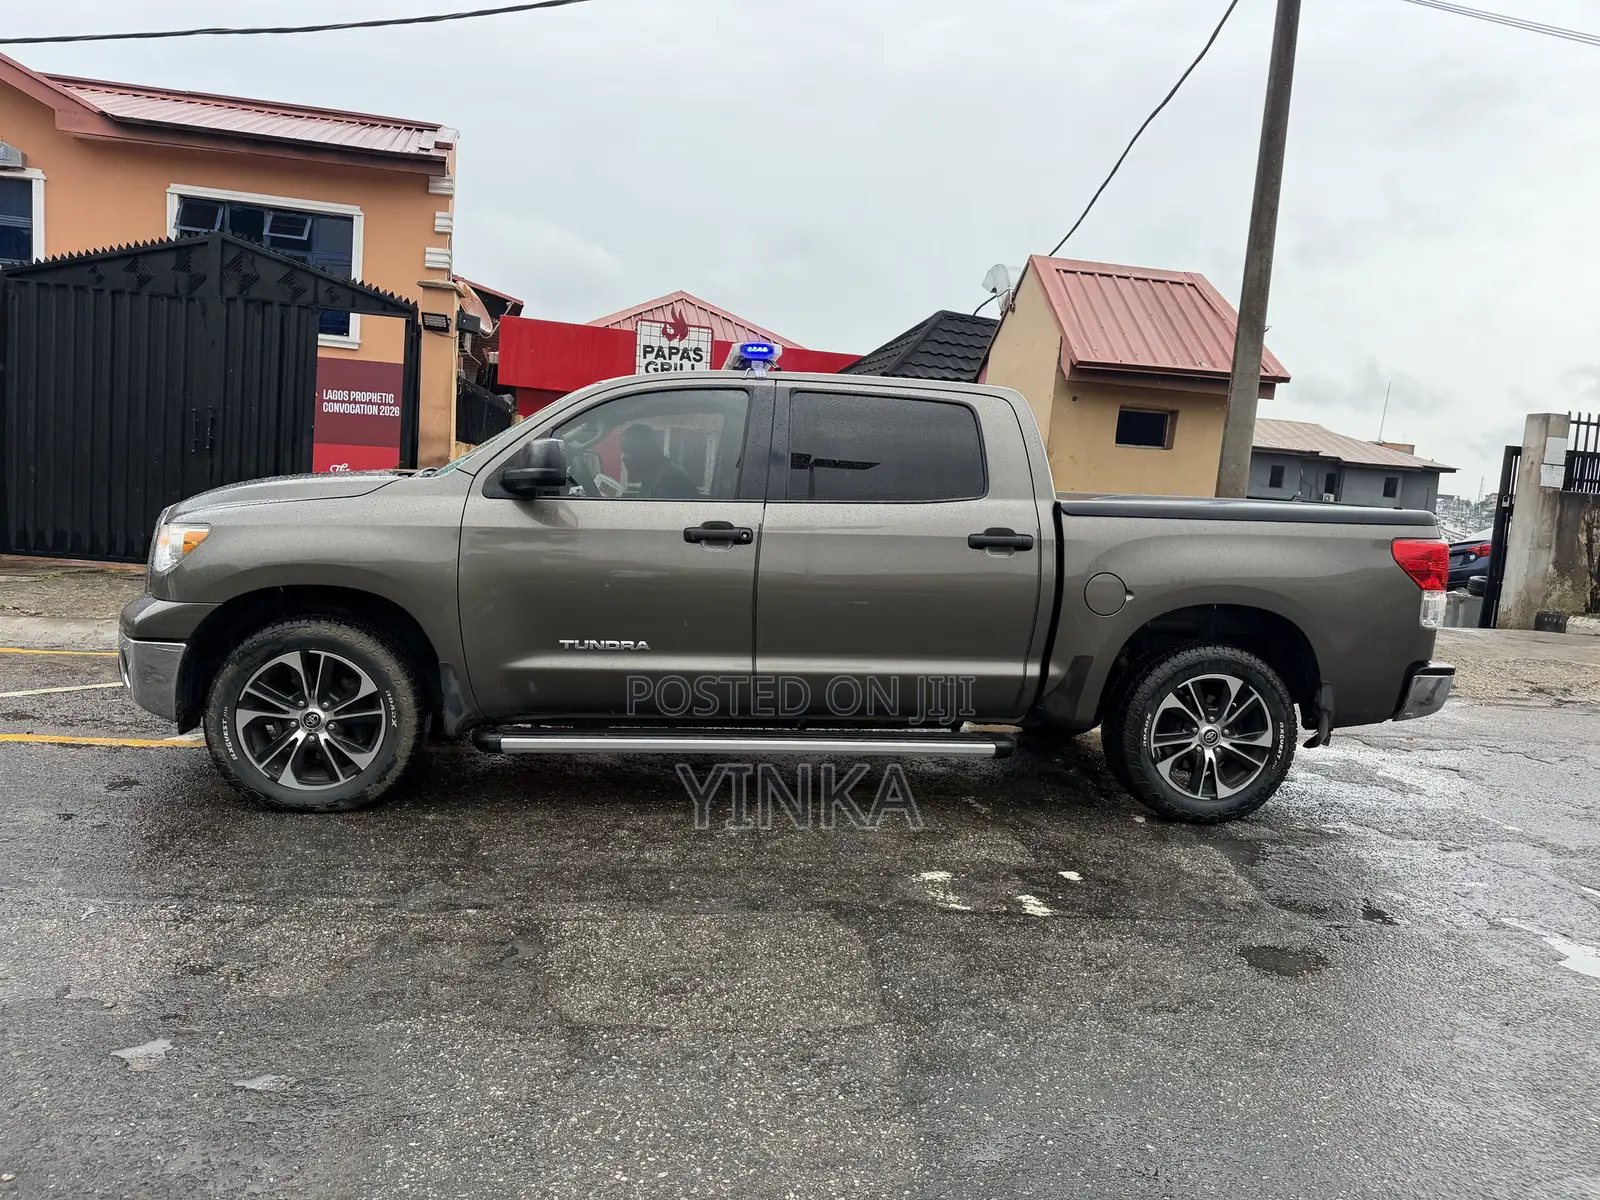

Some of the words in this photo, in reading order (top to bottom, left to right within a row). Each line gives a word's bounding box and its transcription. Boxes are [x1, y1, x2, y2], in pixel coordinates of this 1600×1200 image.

[643, 345, 703, 362] PAPA'S
[323, 389, 348, 400] LAGOS
[350, 391, 394, 403] PROPHETIC
[323, 402, 378, 415] CONVOCATION
[380, 406, 400, 416] 2026
[559, 639, 651, 651] TUNDRA
[385, 690, 397, 728] ROADX
